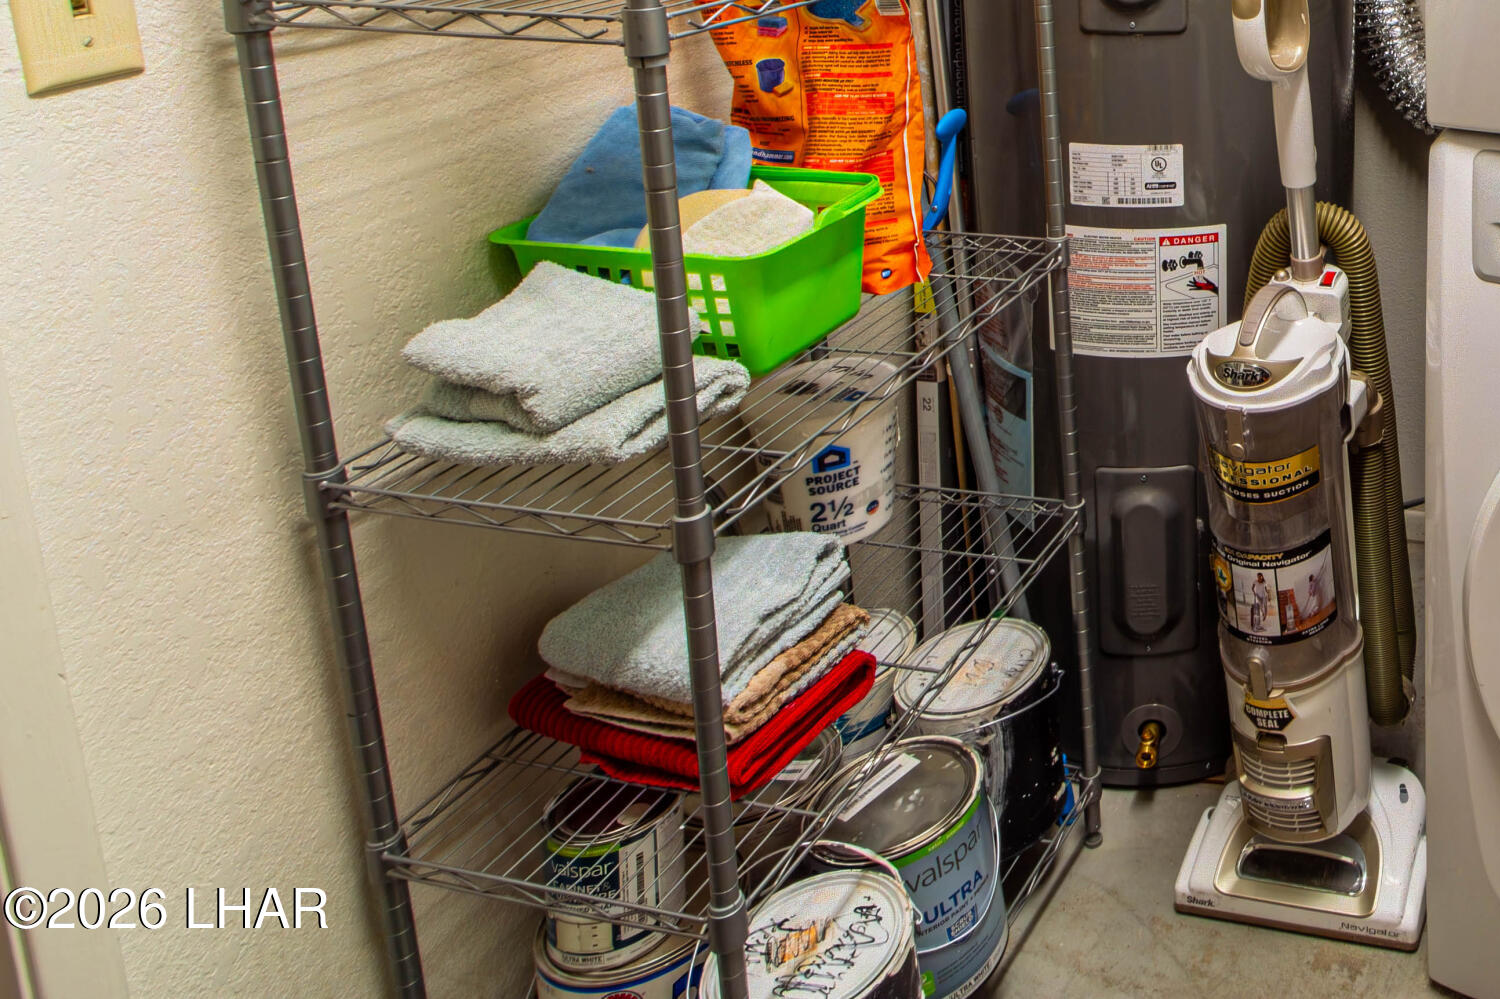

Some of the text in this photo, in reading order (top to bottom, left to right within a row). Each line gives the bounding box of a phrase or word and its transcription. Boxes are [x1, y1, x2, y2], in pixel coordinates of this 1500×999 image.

[1173, 235, 1215, 244] DANGER
[1224, 366, 1259, 382] Shark
[922, 397, 931, 411] 22
[805, 465, 860, 486] PROJECT
[808, 477, 859, 496] SOURCE
[1230, 480, 1310, 499] LOSES SUCTION
[811, 520, 846, 533] Quart
[1227, 550, 1310, 568] Original Navigator
[1246, 704, 1290, 718] COMPLETE
[1256, 718, 1280, 728] SEAL
[904, 819, 983, 893] valspar
[551, 860, 615, 879] valspar
[923, 870, 983, 924] ULTRA
[1186, 895, 1213, 908] Shark
[1341, 922, 1400, 939] Navigator
[581, 955, 602, 963] WHITE
